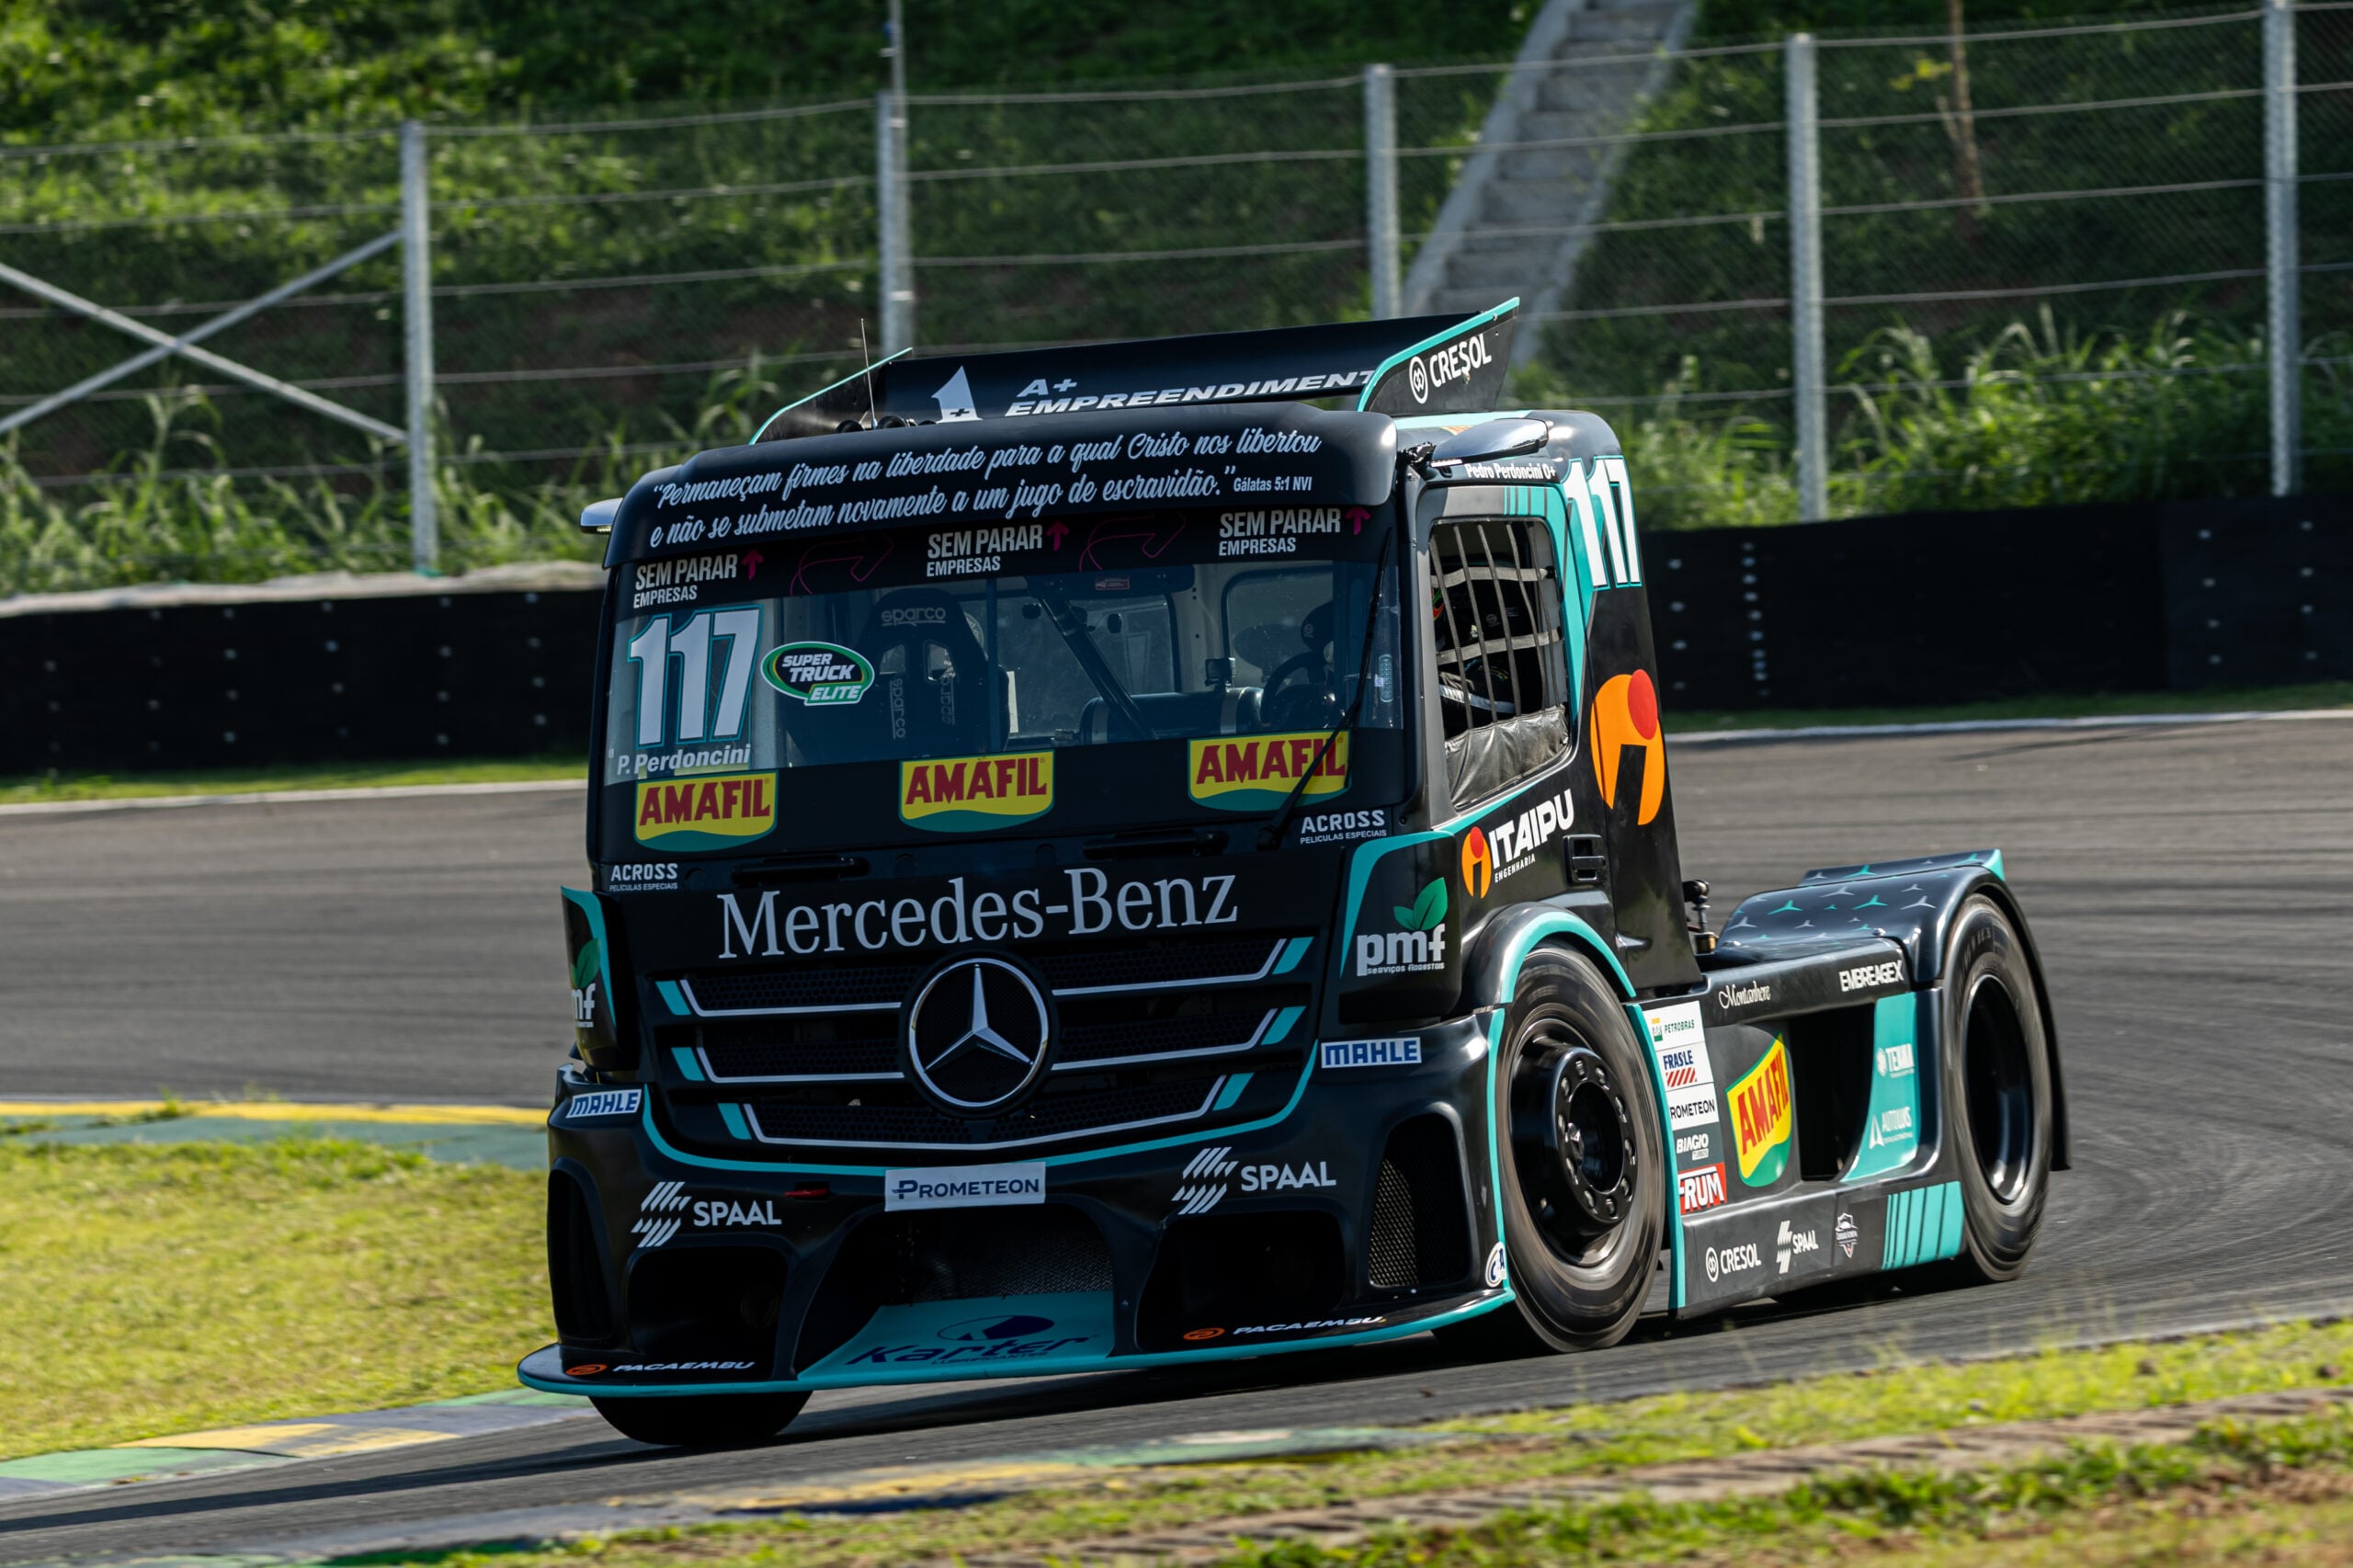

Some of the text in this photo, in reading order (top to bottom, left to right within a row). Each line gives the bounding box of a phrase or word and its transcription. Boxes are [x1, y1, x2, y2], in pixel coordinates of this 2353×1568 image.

[1429, 333, 1492, 388] CRESOL
[1005, 369, 1376, 417] EMPREENDIMENT
[1017, 378, 1078, 398] A+
[782, 462, 849, 501] firmes
[852, 460, 882, 483] na
[886, 446, 985, 479] liberdade
[984, 445, 1042, 481] para
[1047, 445, 1064, 462] a
[1070, 434, 1124, 473] qual
[1127, 431, 1190, 460] Cristo
[1193, 437, 1233, 460] nos
[1236, 427, 1323, 455] libertou
[1465, 463, 1495, 480] Pedro
[1495, 463, 1542, 480] Perdoncini
[1233, 474, 1313, 493] Gálatas 5:1 NVI
[650, 528, 664, 548] e
[665, 515, 705, 545] não
[708, 521, 733, 539] se
[733, 504, 835, 537] submetam
[836, 484, 948, 523] novamente
[952, 489, 969, 506] a
[975, 484, 1008, 510] um
[1006, 477, 1064, 519] jugo
[1067, 472, 1097, 504] de
[1560, 455, 1642, 591] 117
[1219, 507, 1341, 544] SEM PARAR
[926, 522, 1043, 560] SEM PARAR
[1218, 537, 1297, 557] EMPRESAS
[635, 553, 738, 592] SEM PARAR
[926, 555, 1002, 577] EMPRESAS
[633, 585, 698, 608] EMPRESAS
[881, 606, 947, 627] sparco
[781, 652, 833, 668] SUPER
[789, 663, 856, 683] TRUCK
[627, 604, 763, 749] 117
[809, 683, 863, 702] ELITE
[618, 743, 752, 775] P. Perdoncini
[1196, 738, 1346, 785] AMAFIL
[904, 762, 1047, 805] AMAFIL
[638, 778, 770, 826] AMAFIL
[1301, 809, 1386, 835] ACROSS
[1345, 830, 1388, 841] ESPECIAIS
[1488, 789, 1574, 869] ITAIPU
[610, 862, 678, 882] ACROSS
[1495, 854, 1536, 883] ENGENHARIA
[716, 867, 1239, 960] Mercedes-Benz
[1357, 922, 1446, 977] pmf
[1838, 960, 1904, 993] EMBREAGEX
[1665, 1019, 1695, 1035] PETROBRAS
[1325, 1040, 1418, 1065] MAHLE
[570, 1092, 639, 1117] MAHLE
[1670, 1099, 1716, 1119] ROMETEON
[1737, 1049, 1790, 1156] AMAFIL
[1677, 1132, 1709, 1154] BIAGIO
[892, 1177, 1039, 1199] PROMETEON
[1241, 1160, 1337, 1192] SPAAL
[692, 1199, 782, 1227] SPAAL
[1792, 1229, 1819, 1256] SPAAL
[1720, 1243, 1761, 1275] CRESOL
[1233, 1315, 1386, 1335] PACAEMBU
[845, 1333, 1094, 1366] Karter
[612, 1360, 756, 1372] PACAEMBU
